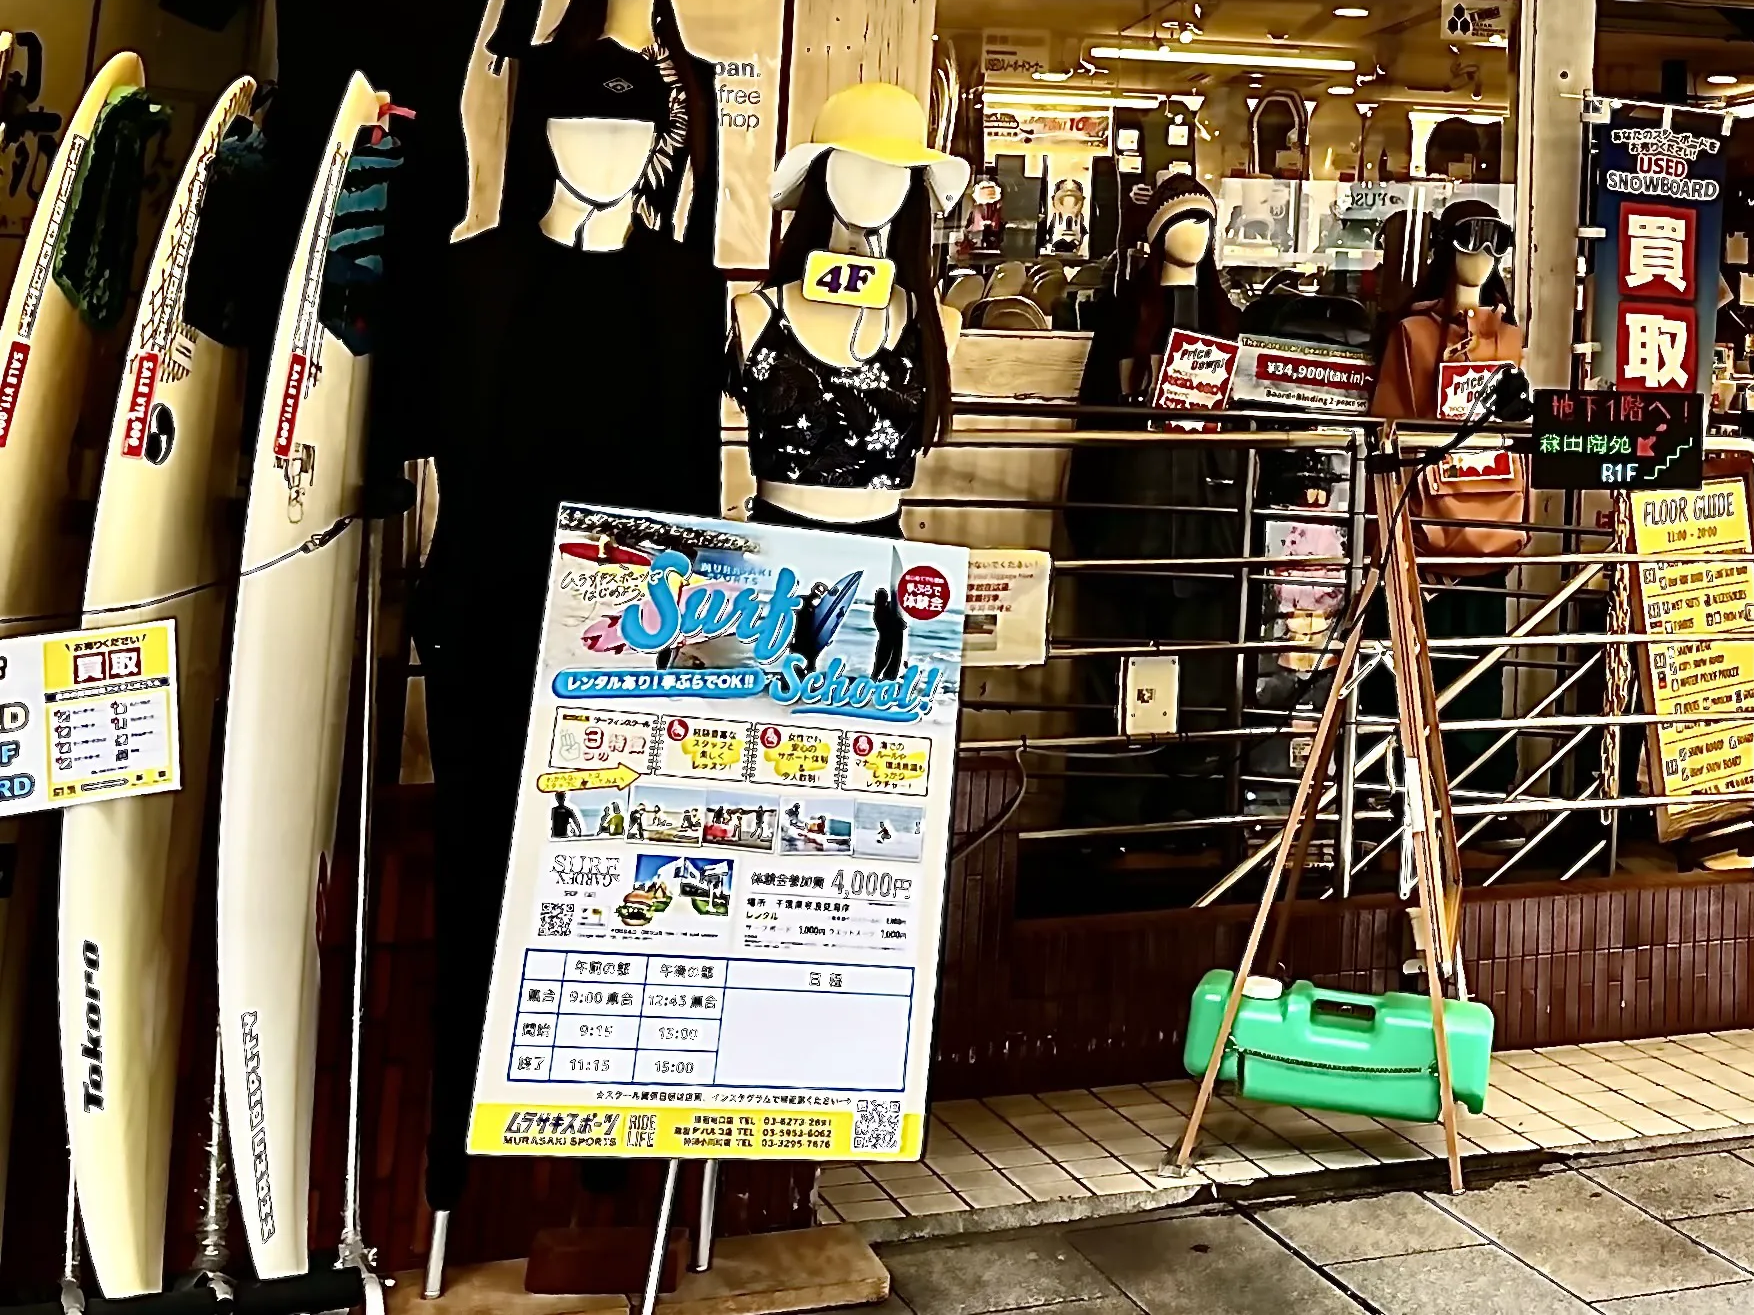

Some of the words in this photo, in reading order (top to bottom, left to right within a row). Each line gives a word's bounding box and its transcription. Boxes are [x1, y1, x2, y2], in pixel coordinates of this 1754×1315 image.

[720, 107, 760, 132] hop
[1639, 156, 1686, 177] USED
[1608, 170, 1719, 199] SNOWBOARD
[813, 267, 872, 295] 4F
[1625, 213, 1688, 389] 買取
[1179, 347, 1213, 362] Price
[6, 351, 24, 385] SALE
[137, 359, 154, 394] SALE
[287, 364, 302, 395] SALE
[1453, 374, 1485, 396] Price
[1601, 462, 1639, 483] B1F
[1643, 496, 1689, 527] FLOOR
[1693, 492, 1735, 521] GUIDE
[621, 549, 805, 666] Surf
[902, 592, 944, 611] 体験会
[831, 868, 914, 900] 4,000円
[568, 990, 604, 1005] 9:00
[81, 939, 104, 1113] Tokoro
[569, 1058, 611, 1072] 11:15
[504, 1111, 621, 1136] ムラサキスポーツ
[736, 1127, 755, 1137] TEL
[738, 1116, 757, 1126] TEL
[502, 1135, 567, 1147] MURASAKI
[569, 1136, 618, 1148] SPORTS
[626, 1130, 656, 1148] LIFE
[735, 1138, 754, 1148] TEL
